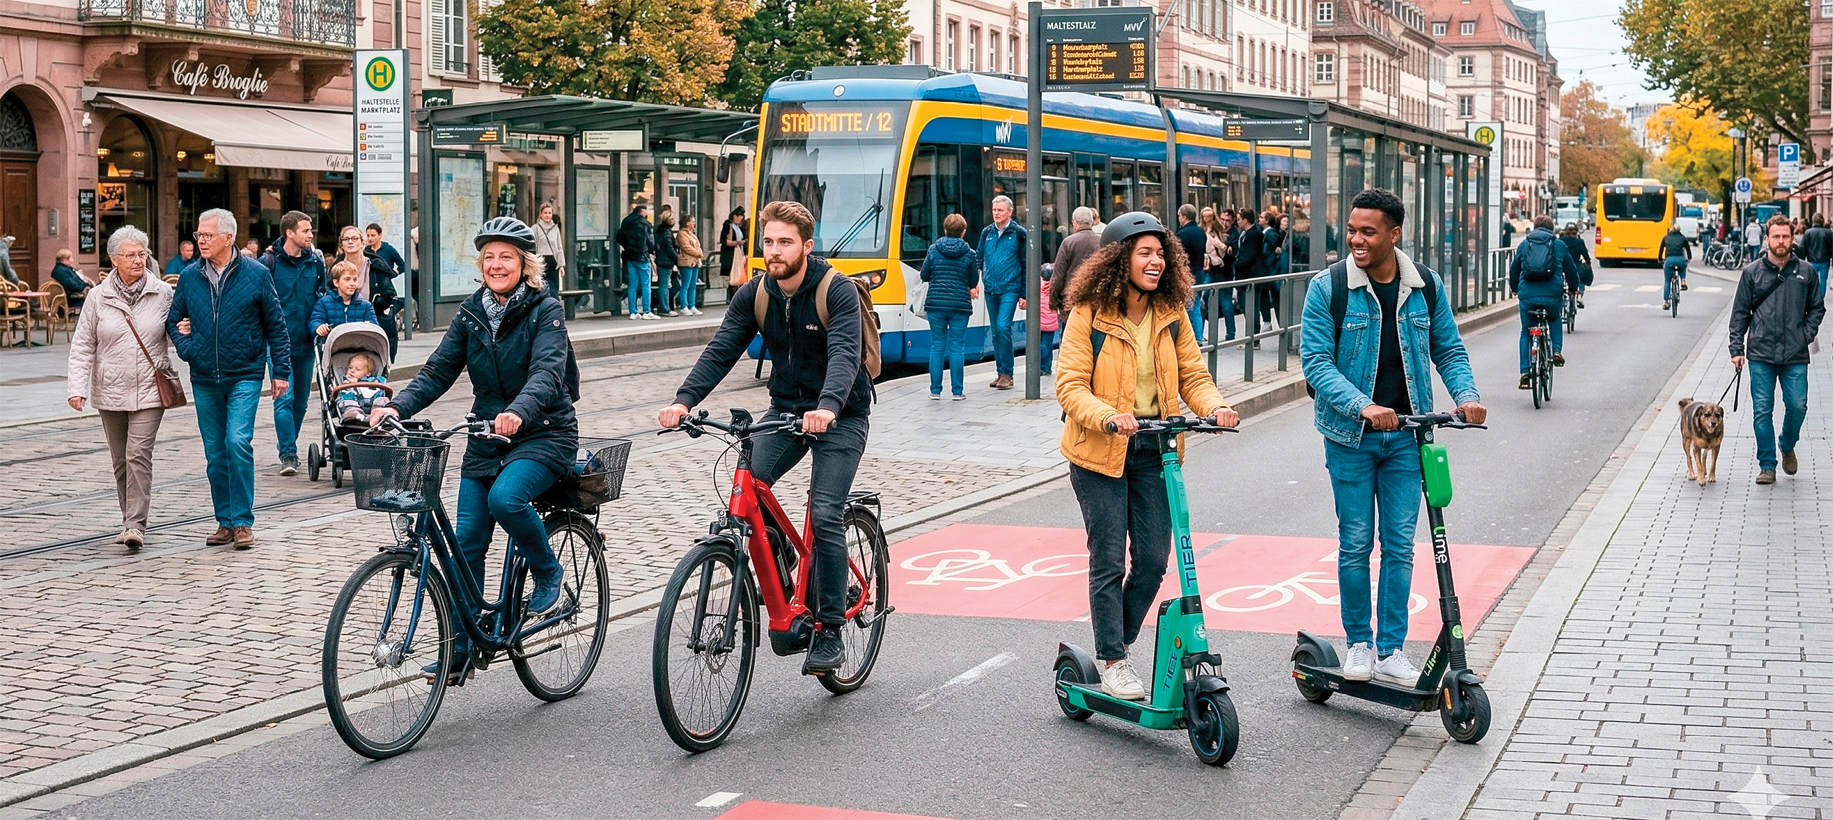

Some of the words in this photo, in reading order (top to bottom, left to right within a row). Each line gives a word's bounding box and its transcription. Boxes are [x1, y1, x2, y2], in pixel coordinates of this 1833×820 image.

[172, 60, 209, 95] Café
[212, 63, 269, 99] Broglie
[373, 64, 387, 84] H
[361, 98, 400, 106] HALTESTELLE
[781, 112, 863, 133] STADTMITTE
[876, 112, 892, 131] 12
[1480, 130, 1490, 143] H
[1783, 146, 1795, 160] P
[1180, 534, 1197, 588] TIER
